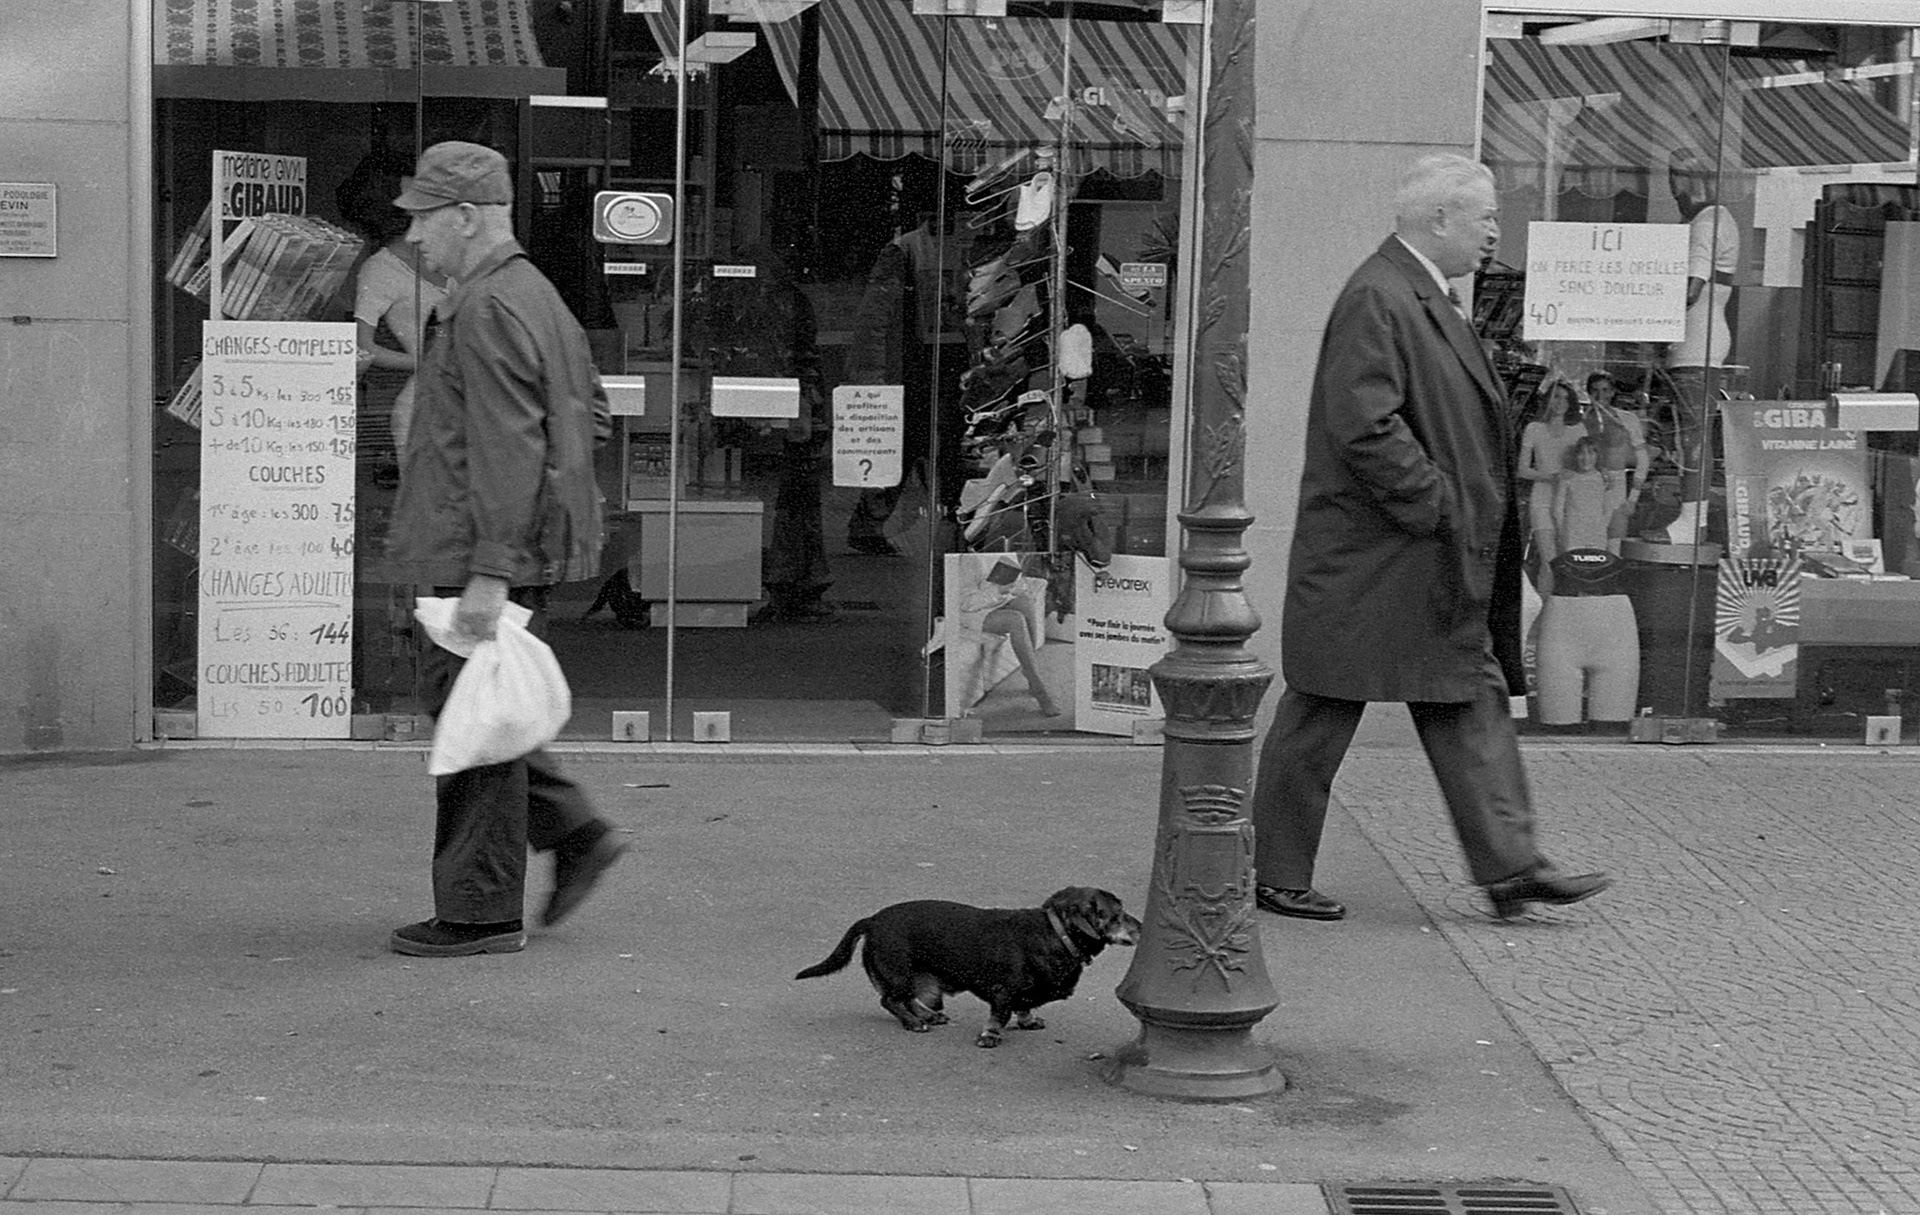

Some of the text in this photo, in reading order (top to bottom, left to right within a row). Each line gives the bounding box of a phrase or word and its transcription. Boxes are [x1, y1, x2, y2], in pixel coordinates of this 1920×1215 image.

[231, 182, 305, 217] GIBAUD
[1599, 261, 1623, 274] LES
[1559, 280, 1664, 296] SANS DOULEUR
[213, 375, 224, 396] 3
[846, 402, 888, 410] profitera
[210, 406, 223, 427] 5
[849, 413, 898, 421] disparition
[1764, 409, 1827, 428] GIBA
[249, 465, 325, 483] COUCHES
[859, 458, 873, 481] ?
[291, 503, 319, 521] 300
[1571, 554, 1607, 562] TURBO
[201, 570, 285, 598] CHANGES
